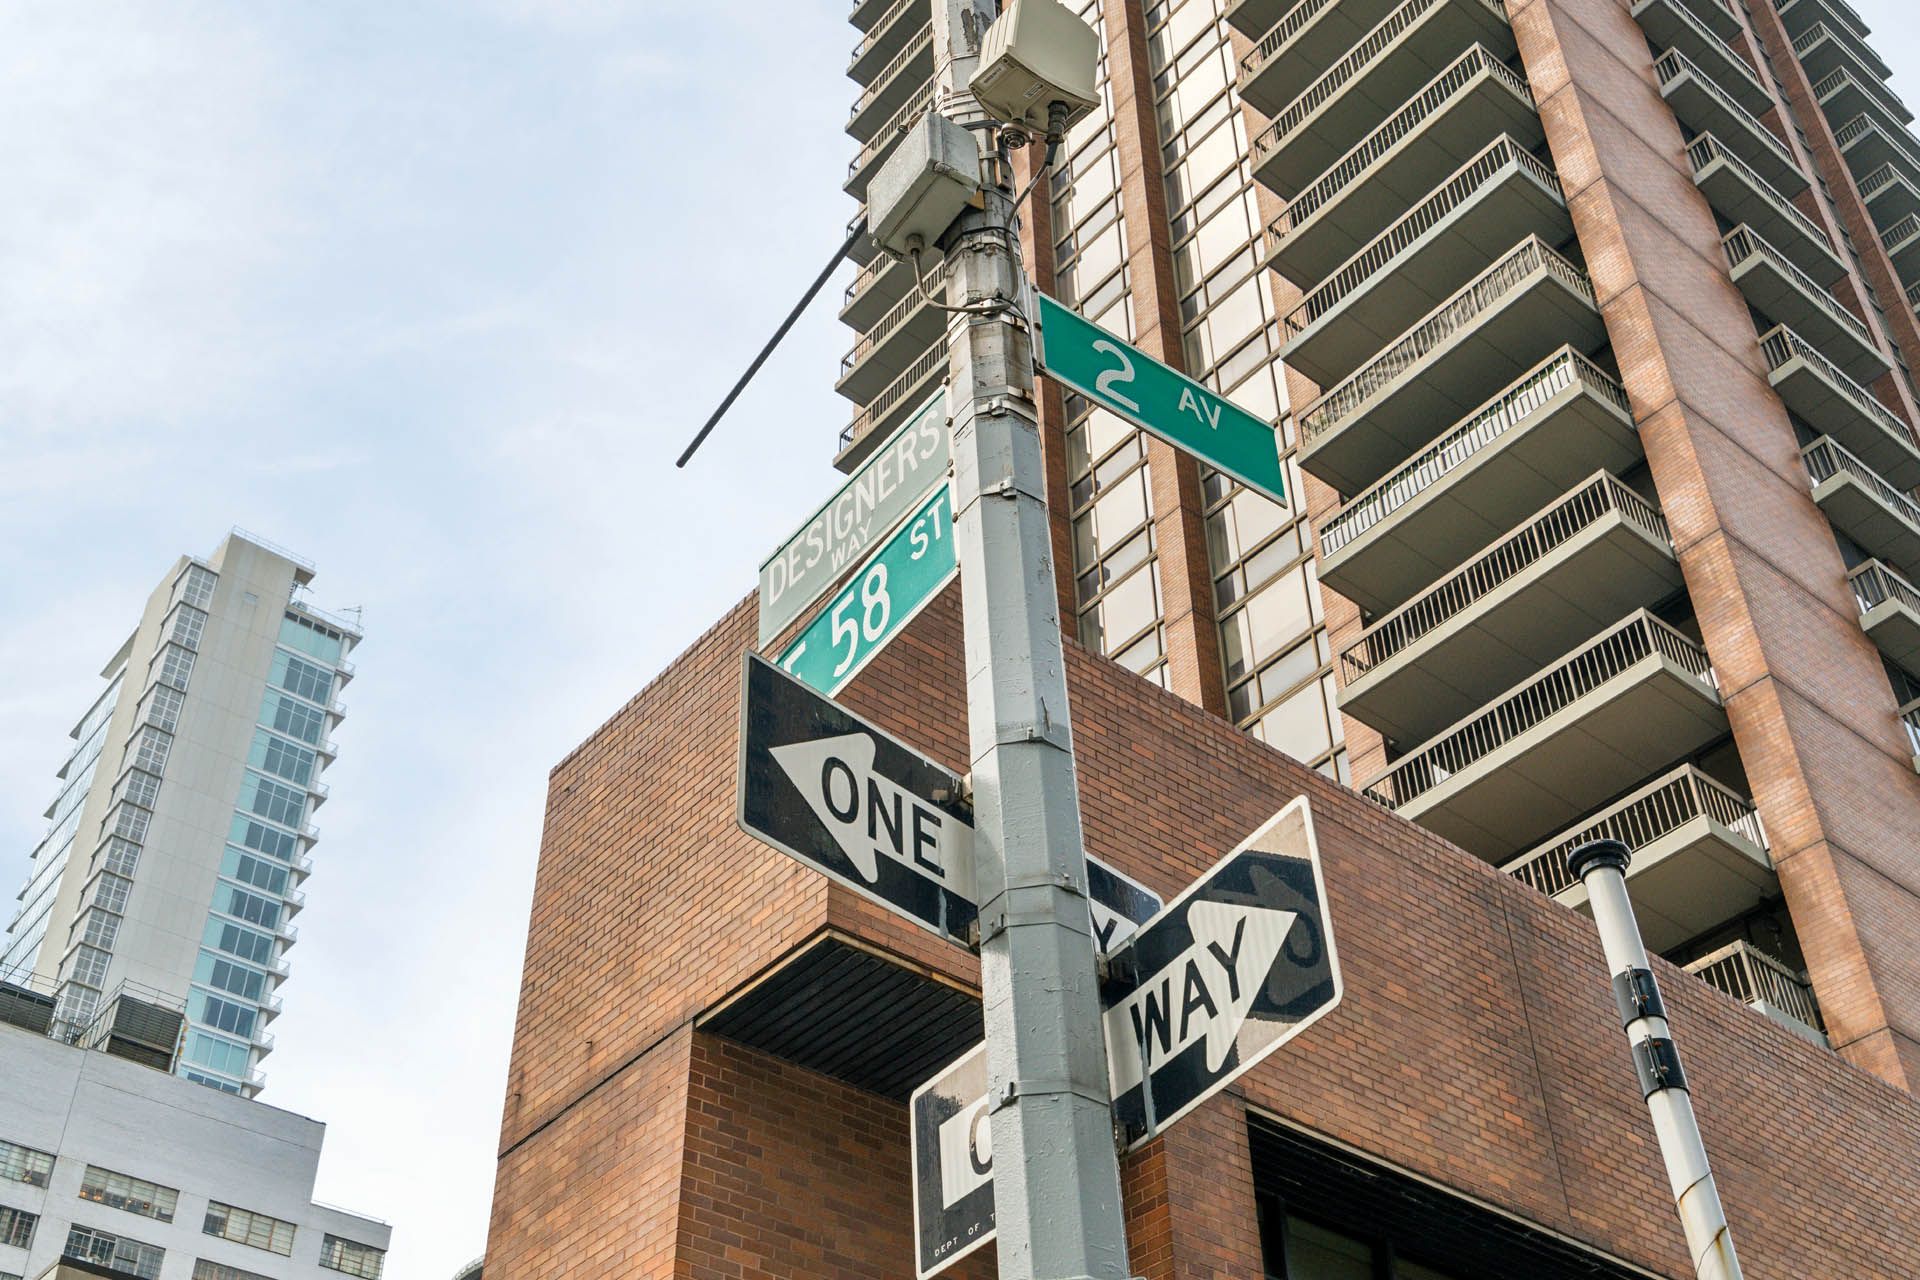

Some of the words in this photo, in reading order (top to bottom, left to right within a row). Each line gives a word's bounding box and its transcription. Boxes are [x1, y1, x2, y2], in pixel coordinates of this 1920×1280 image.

[1092, 339, 1140, 413] 2
[1178, 387, 1221, 430] AV
[769, 410, 940, 606] DESIGNERS
[832, 516, 872, 573] WAY
[831, 563, 891, 678] 58
[910, 496, 945, 560] ST
[821, 756, 946, 880] ONE
[1129, 915, 1248, 1067] WAY
[934, 1237, 958, 1257] DEPT
[968, 1222, 980, 1236] OF
